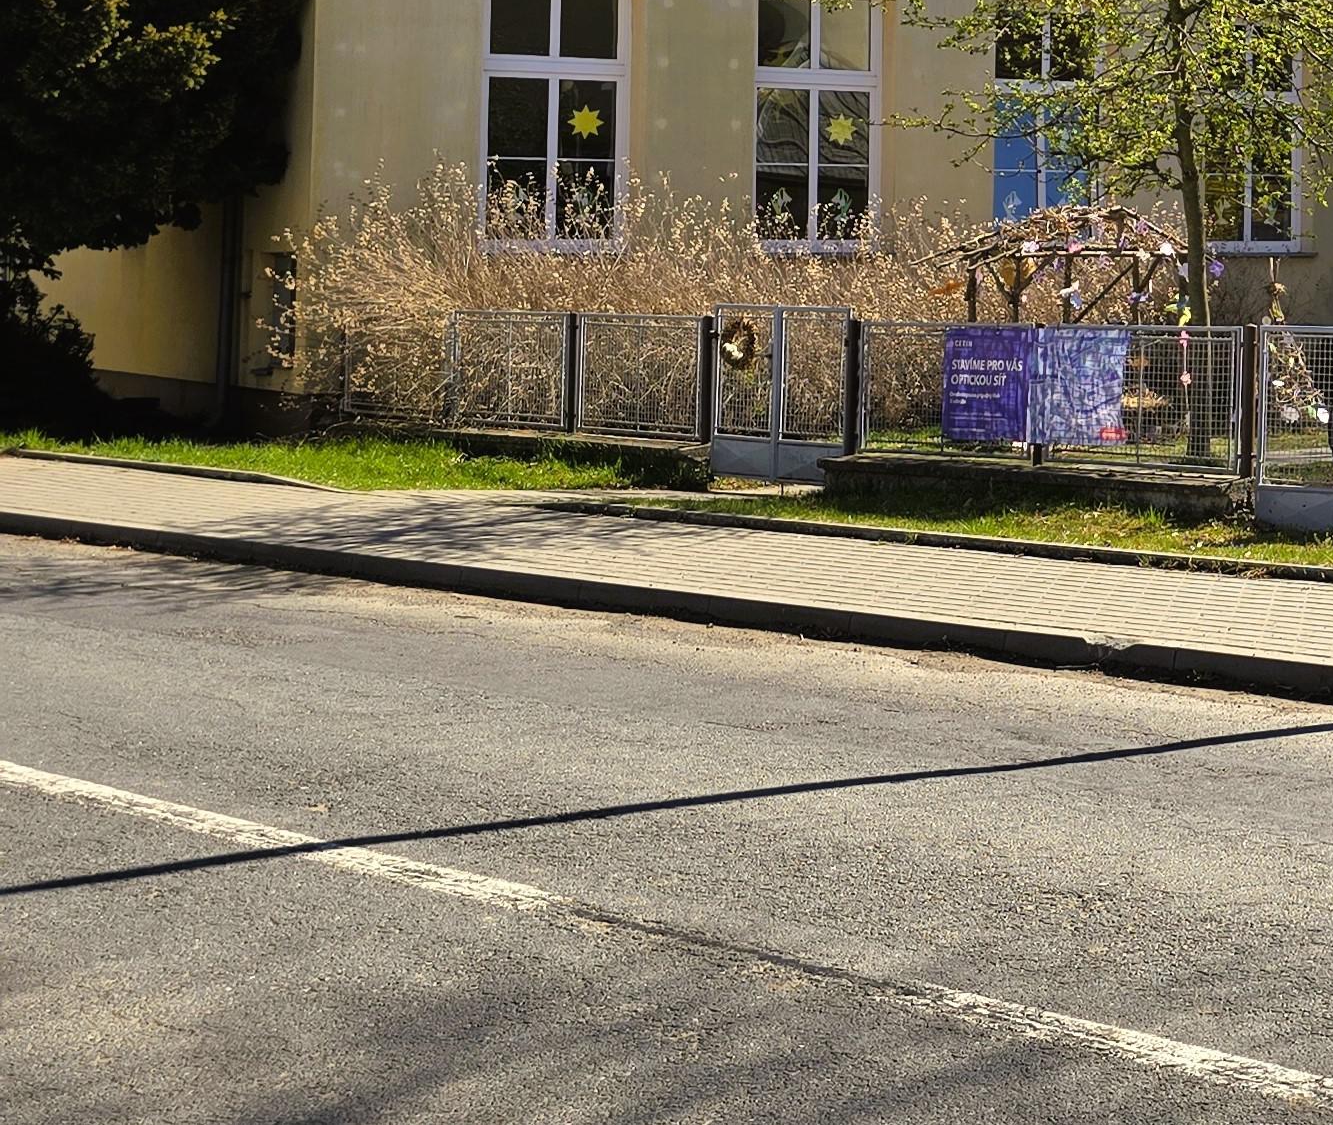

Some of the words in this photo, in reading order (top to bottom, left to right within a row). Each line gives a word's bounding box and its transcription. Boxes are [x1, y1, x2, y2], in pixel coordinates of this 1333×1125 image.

[952, 357, 985, 370] STAVÍME
[987, 359, 1004, 371] PRO
[1006, 357, 1023, 371] VÁS
[951, 374, 992, 385] OPTICKOU
